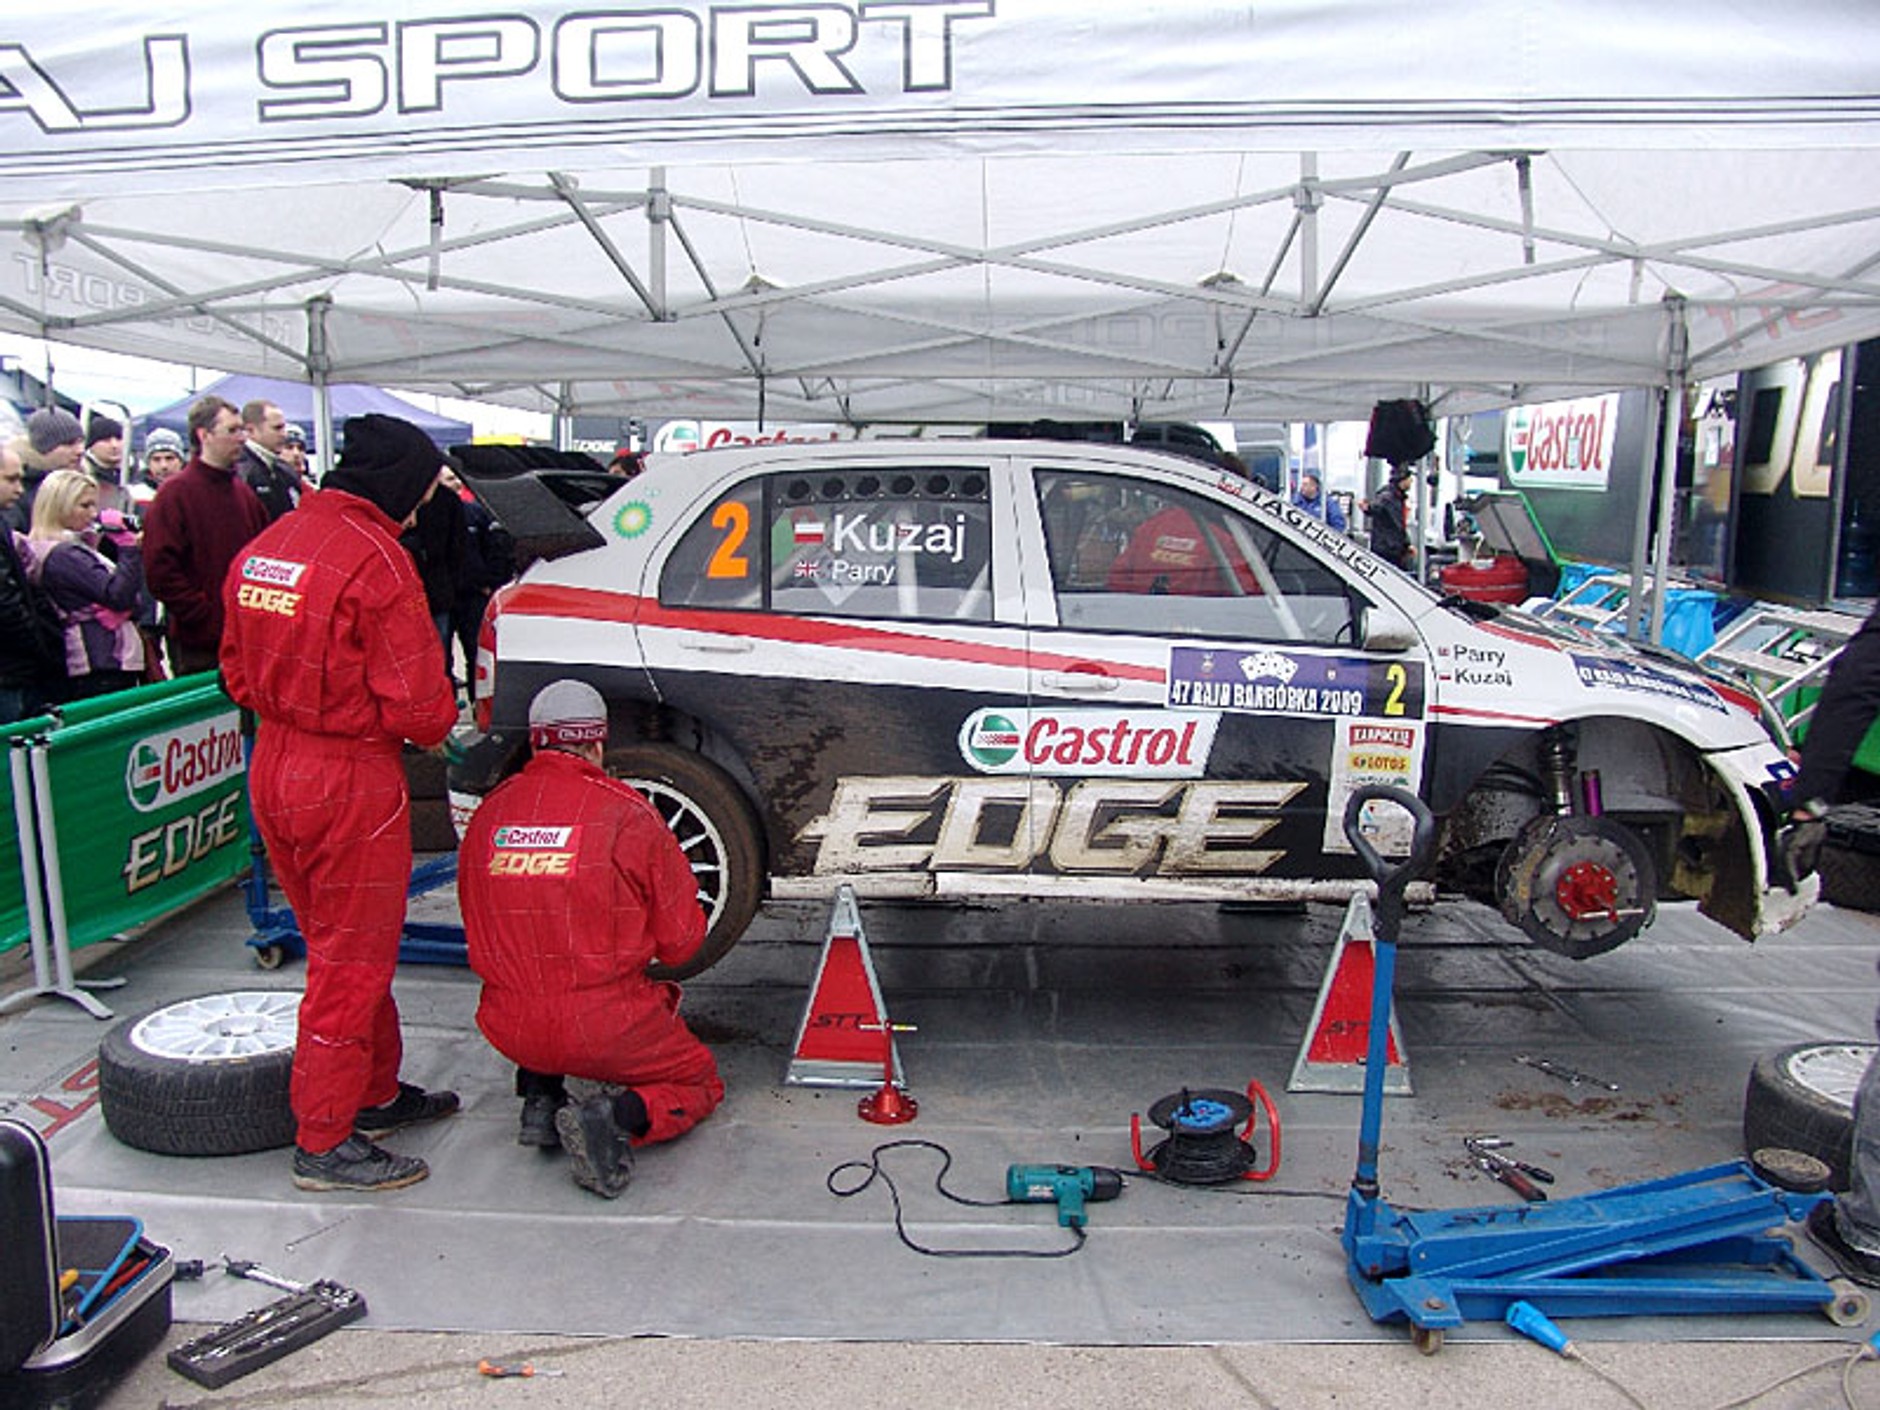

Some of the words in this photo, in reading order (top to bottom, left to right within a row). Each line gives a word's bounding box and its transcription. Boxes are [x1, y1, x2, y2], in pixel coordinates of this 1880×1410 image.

[256, 0, 996, 122] SPORT
[707, 500, 749, 579] 2
[832, 513, 965, 563] Kuzaj
[832, 560, 895, 585] Parry
[237, 584, 303, 617] EDGE
[1454, 645, 1506, 667] Parry
[1171, 680, 1192, 703] 47
[1384, 663, 1407, 716] 2
[1455, 667, 1513, 687] Kuzaj
[1024, 717, 1198, 766] Castrol
[1368, 756, 1407, 770] LOTOS
[122, 790, 241, 894] EDGE
[508, 829, 561, 846] Castrol
[794, 776, 1308, 875] EDGE
[488, 852, 577, 875] EDGE
